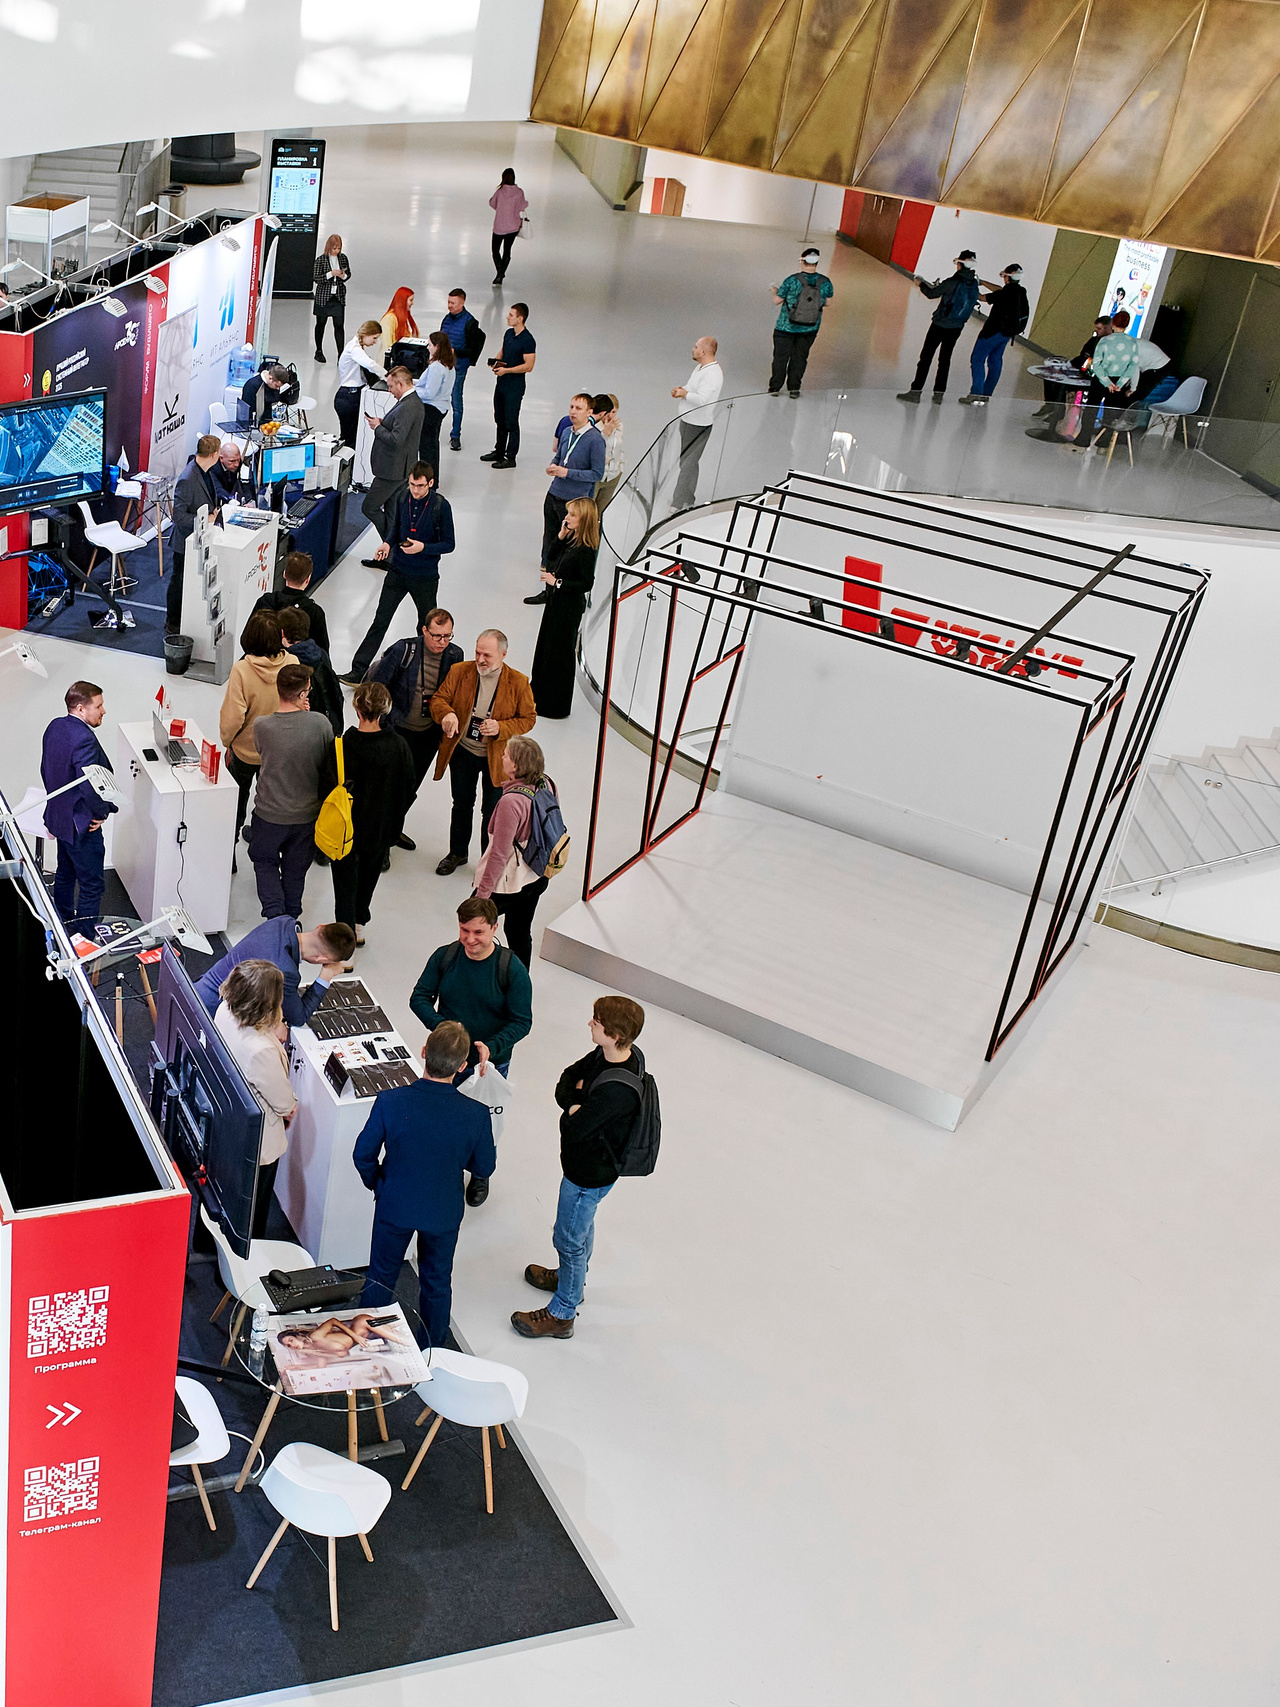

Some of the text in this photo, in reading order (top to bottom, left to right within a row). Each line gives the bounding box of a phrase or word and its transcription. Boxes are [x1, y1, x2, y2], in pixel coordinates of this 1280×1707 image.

[1126, 254, 1151, 271] business
[34, 1356, 97, 1374] Программа
[19, 1516, 102, 1538] Телеграм-канал
